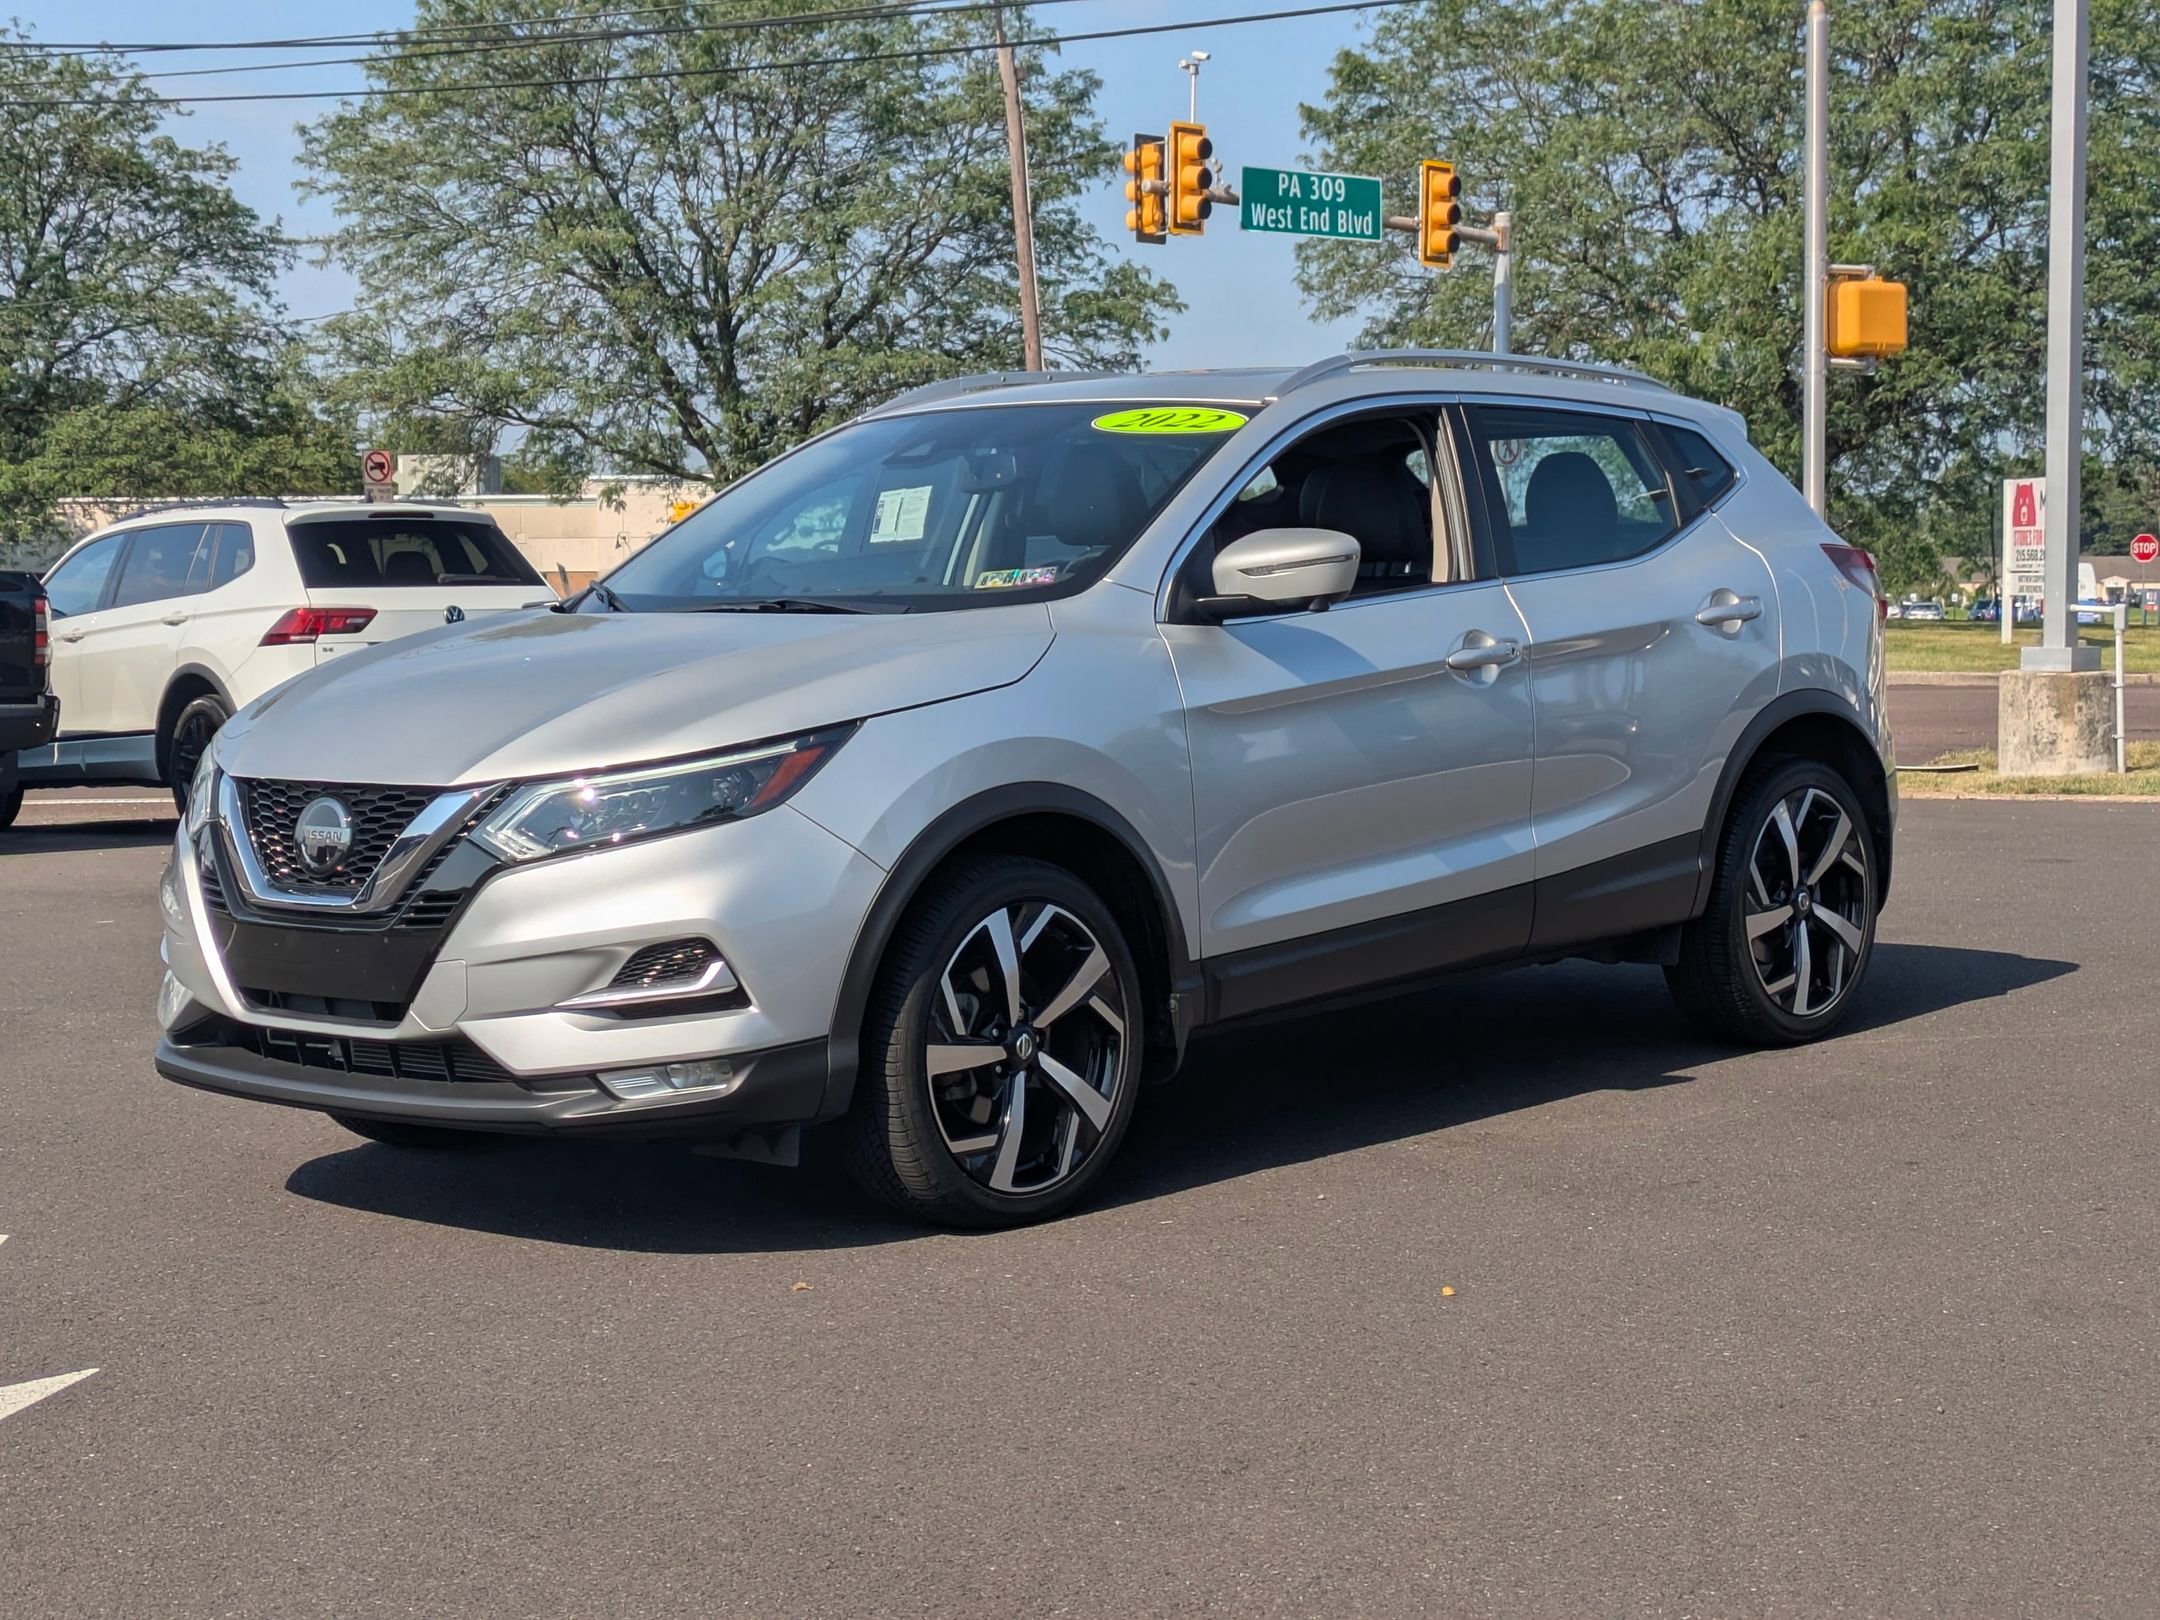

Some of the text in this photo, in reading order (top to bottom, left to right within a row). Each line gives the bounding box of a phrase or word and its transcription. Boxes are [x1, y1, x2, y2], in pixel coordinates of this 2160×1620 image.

[1278, 173, 1345, 202] PA 309
[1251, 203, 1373, 235] West End Blvd
[1111, 413, 1227, 429] 2022
[2133, 542, 2156, 554] STOP
[304, 829, 342, 841] NISSAN
